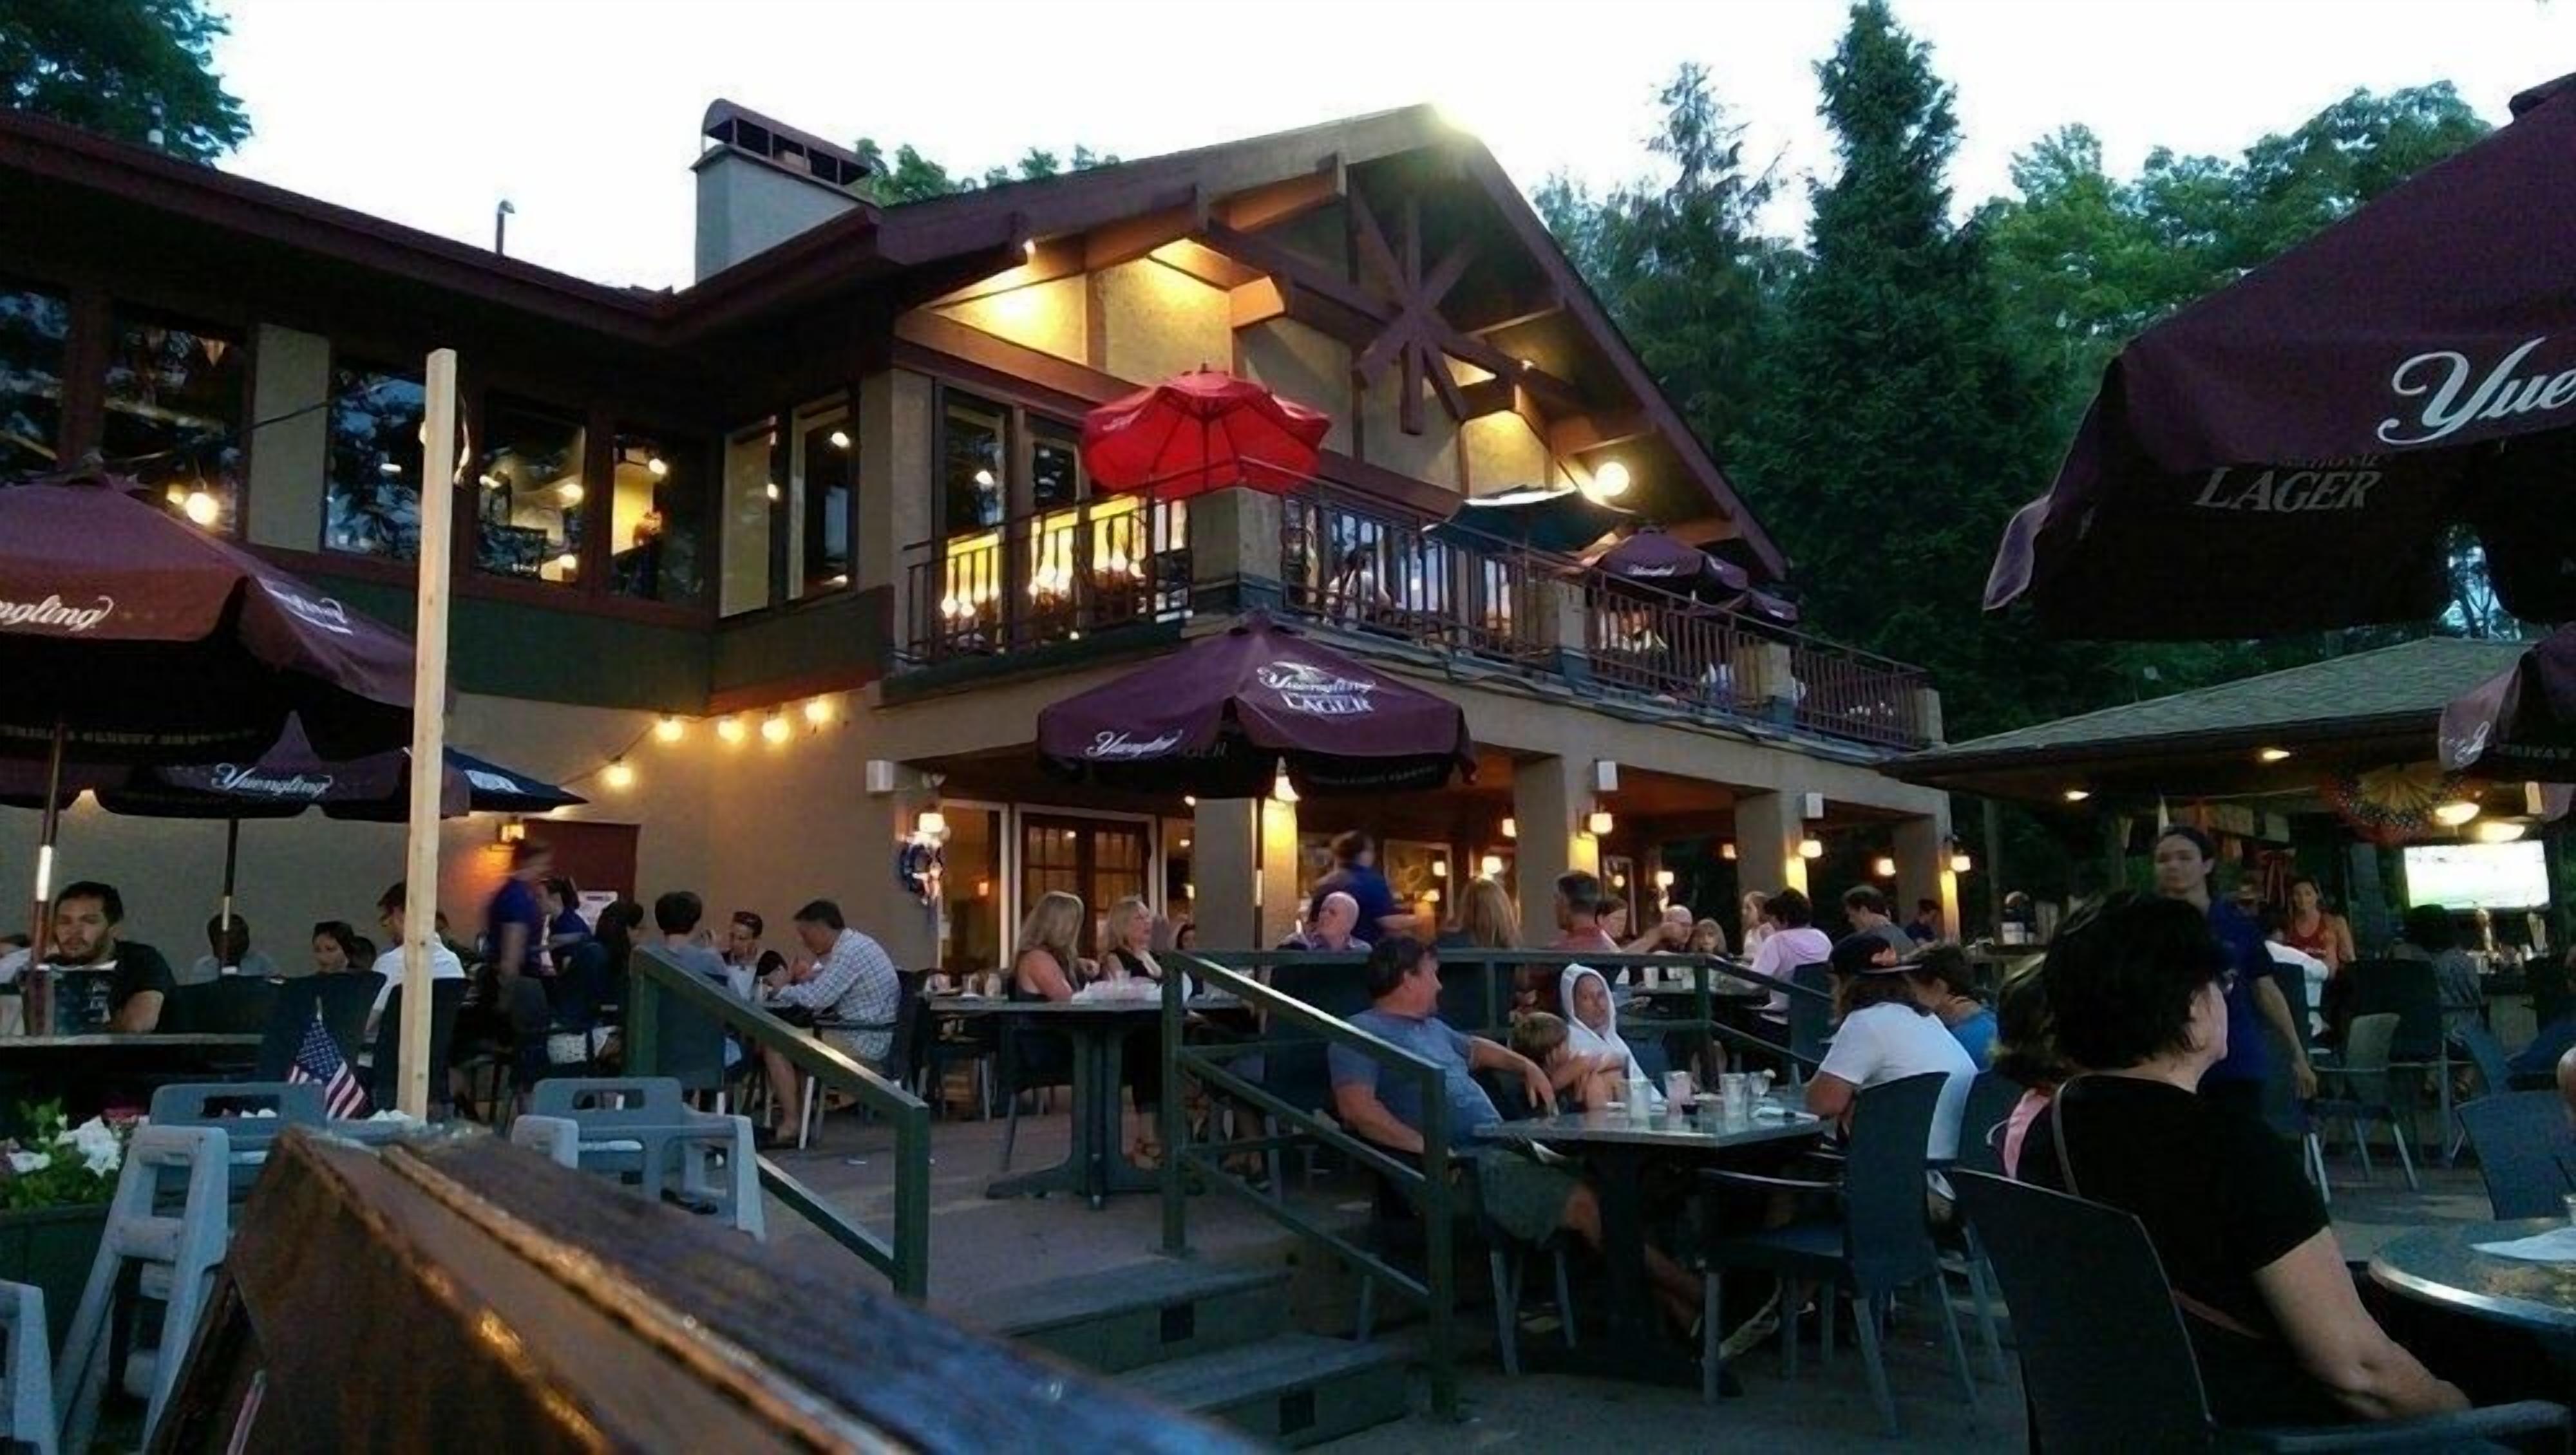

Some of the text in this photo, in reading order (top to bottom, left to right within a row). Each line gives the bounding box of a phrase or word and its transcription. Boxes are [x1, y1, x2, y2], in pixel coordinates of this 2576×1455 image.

[2378, 336, 2576, 444] Yue
[2192, 466, 2382, 513] LAGER
[211, 762, 334, 799] Yuengling
